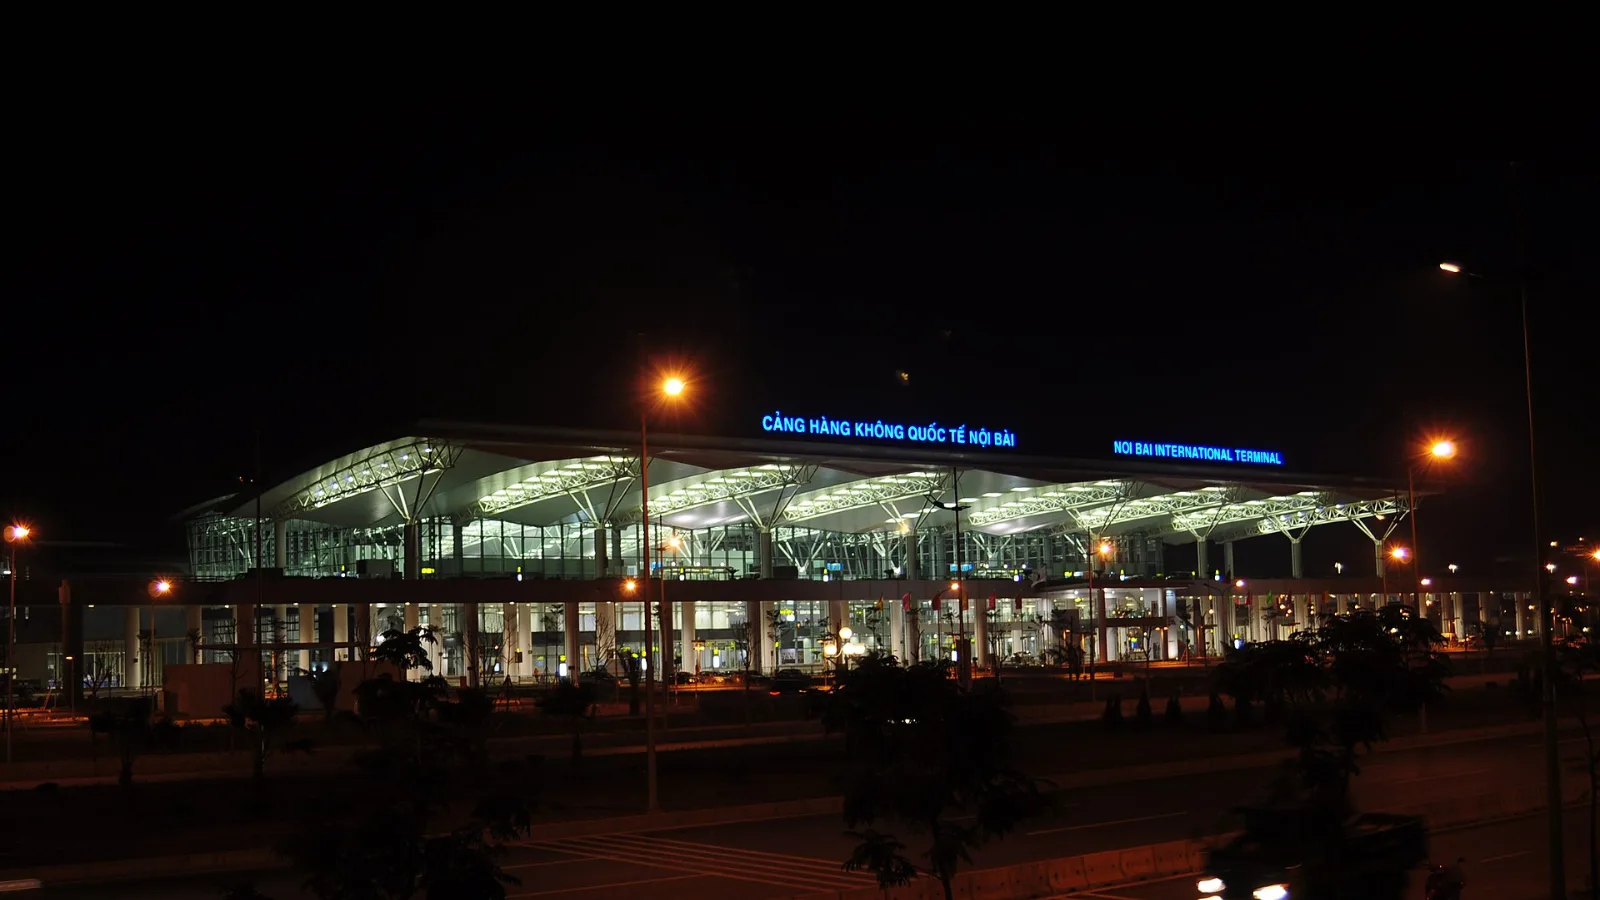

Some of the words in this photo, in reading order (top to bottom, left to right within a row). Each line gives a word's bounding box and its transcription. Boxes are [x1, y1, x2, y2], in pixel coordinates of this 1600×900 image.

[762, 410, 805, 432] CẢNG
[809, 416, 851, 436] HÀNG
[855, 420, 904, 440] KHÔNG
[908, 421, 946, 442] QUỐC
[949, 424, 966, 443] TẾ
[969, 428, 991, 447] NỘI
[994, 429, 1015, 447] BÀI
[1113, 440, 1133, 454] NOI
[1135, 443, 1153, 456] BAI
[1155, 444, 1233, 461] INTERNATIONAL
[1234, 449, 1282, 465] TERMINAL
